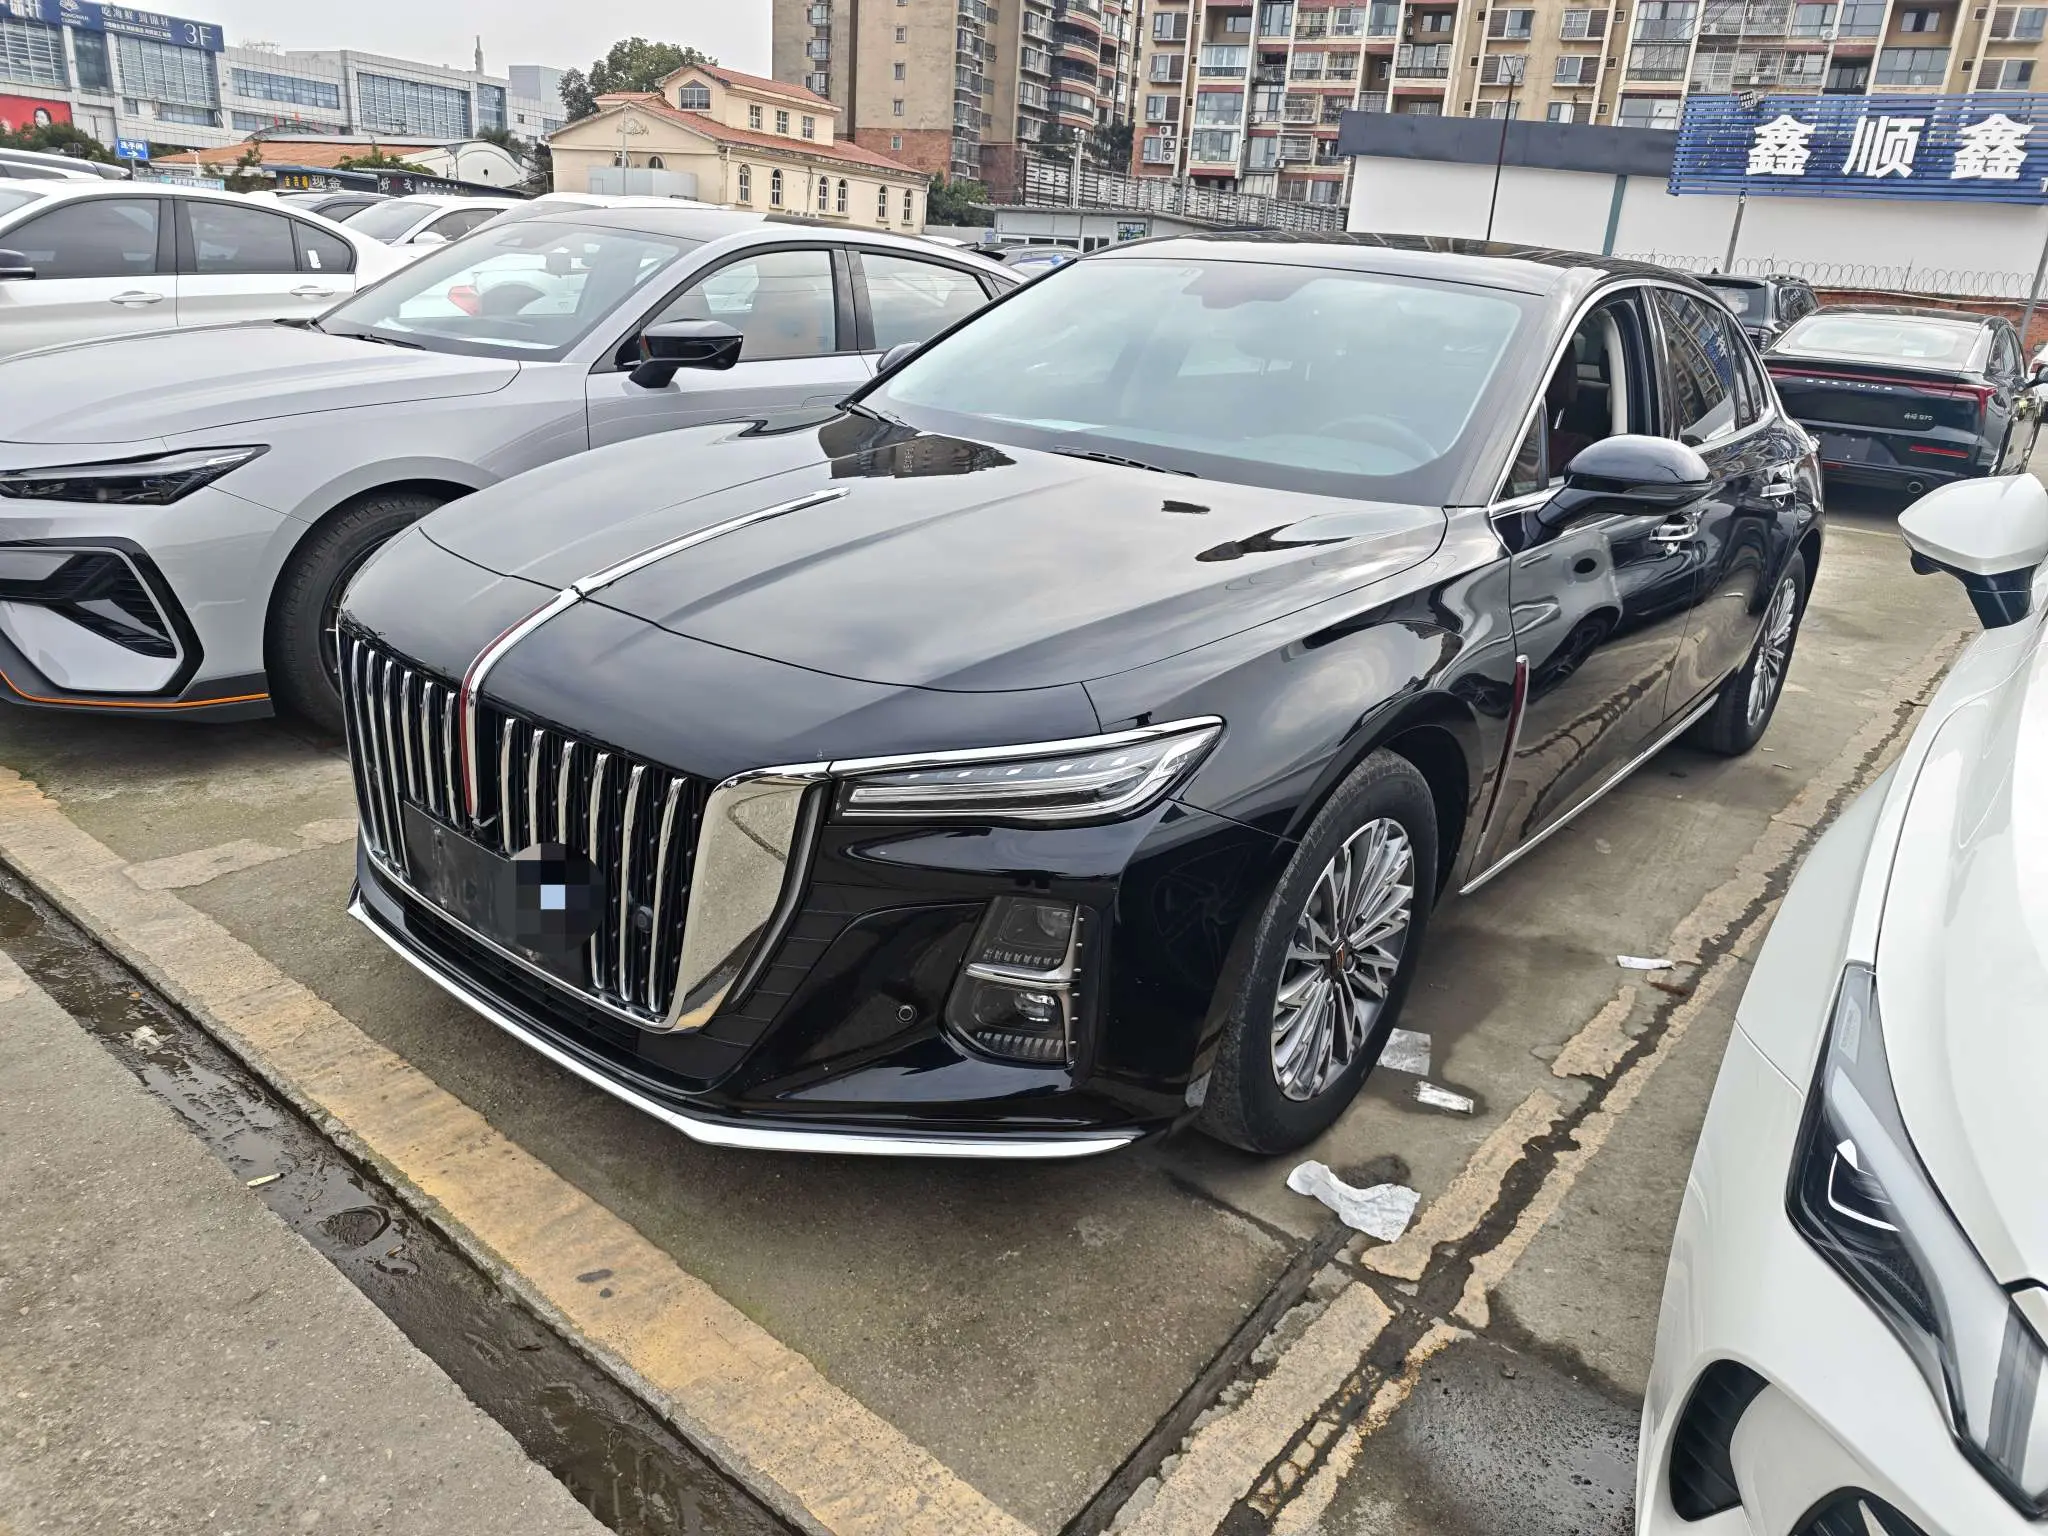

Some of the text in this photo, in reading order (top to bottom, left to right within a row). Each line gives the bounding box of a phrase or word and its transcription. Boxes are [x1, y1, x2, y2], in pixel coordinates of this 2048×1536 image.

[184, 23, 213, 46] 3F
[1745, 113, 2034, 180] 鑫顺鑫
